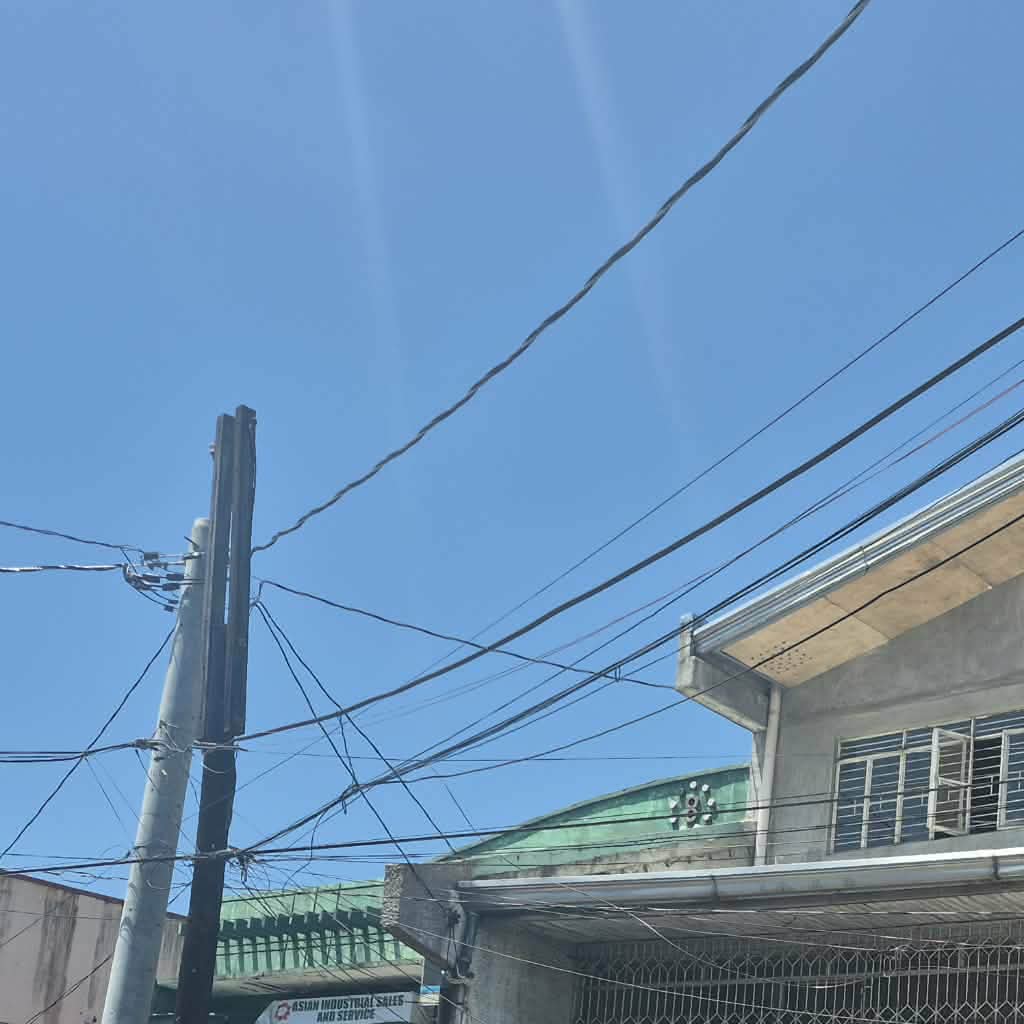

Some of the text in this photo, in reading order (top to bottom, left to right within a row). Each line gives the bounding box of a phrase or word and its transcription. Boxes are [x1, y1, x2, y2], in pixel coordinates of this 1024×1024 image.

[292, 994, 404, 1012] ASIAN INDUSTRIAL SALES
[316, 1008, 376, 1023] AND SERVICE
